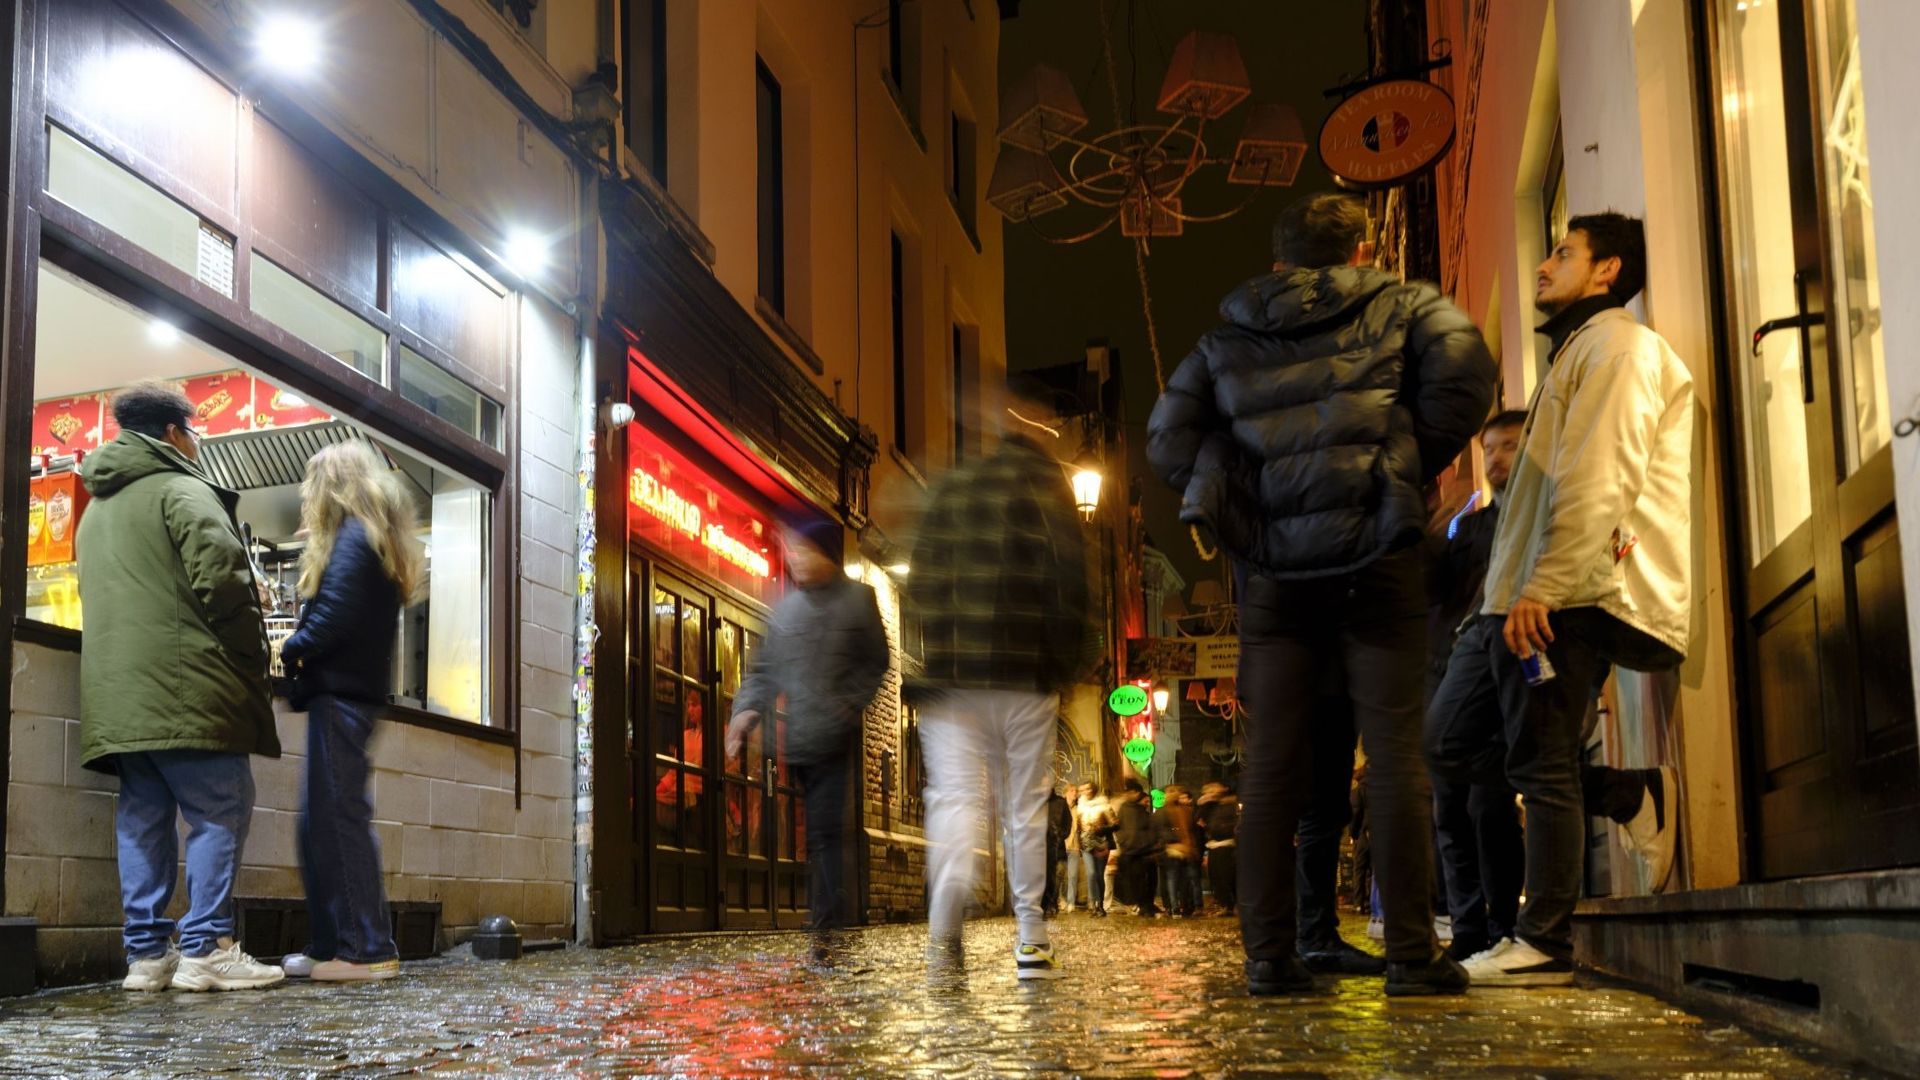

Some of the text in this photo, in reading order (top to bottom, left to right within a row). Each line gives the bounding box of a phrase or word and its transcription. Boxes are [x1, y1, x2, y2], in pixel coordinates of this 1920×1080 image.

[1335, 84, 1433, 123] TEA ROOM
[1347, 140, 1436, 178] WAFFLES
